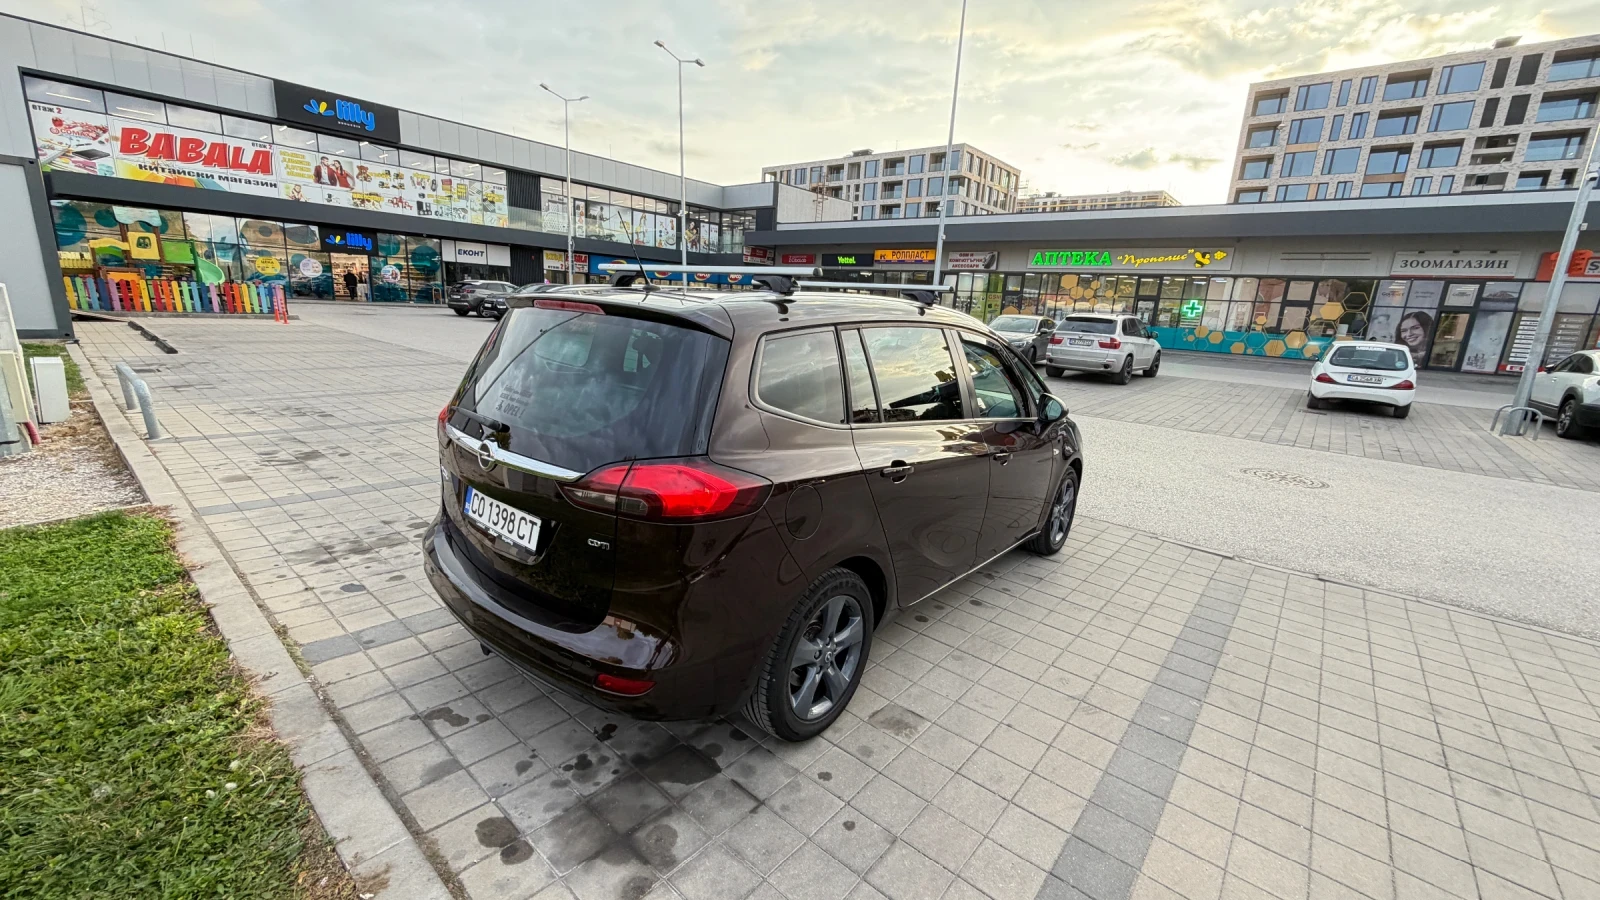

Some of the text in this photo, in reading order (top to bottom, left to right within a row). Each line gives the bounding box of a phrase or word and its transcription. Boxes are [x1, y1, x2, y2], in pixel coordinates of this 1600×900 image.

[336, 99, 375, 131] lilly
[119, 127, 274, 175] BABALA
[218, 174, 278, 189] магазин
[346, 232, 372, 251] lilly
[1031, 251, 1112, 266] АПТЕКА
[1399, 259, 1509, 269] ЗООМАГАЗИН
[470, 491, 485, 516] CO
[487, 502, 516, 537] 1398
[517, 516, 538, 545] CT
